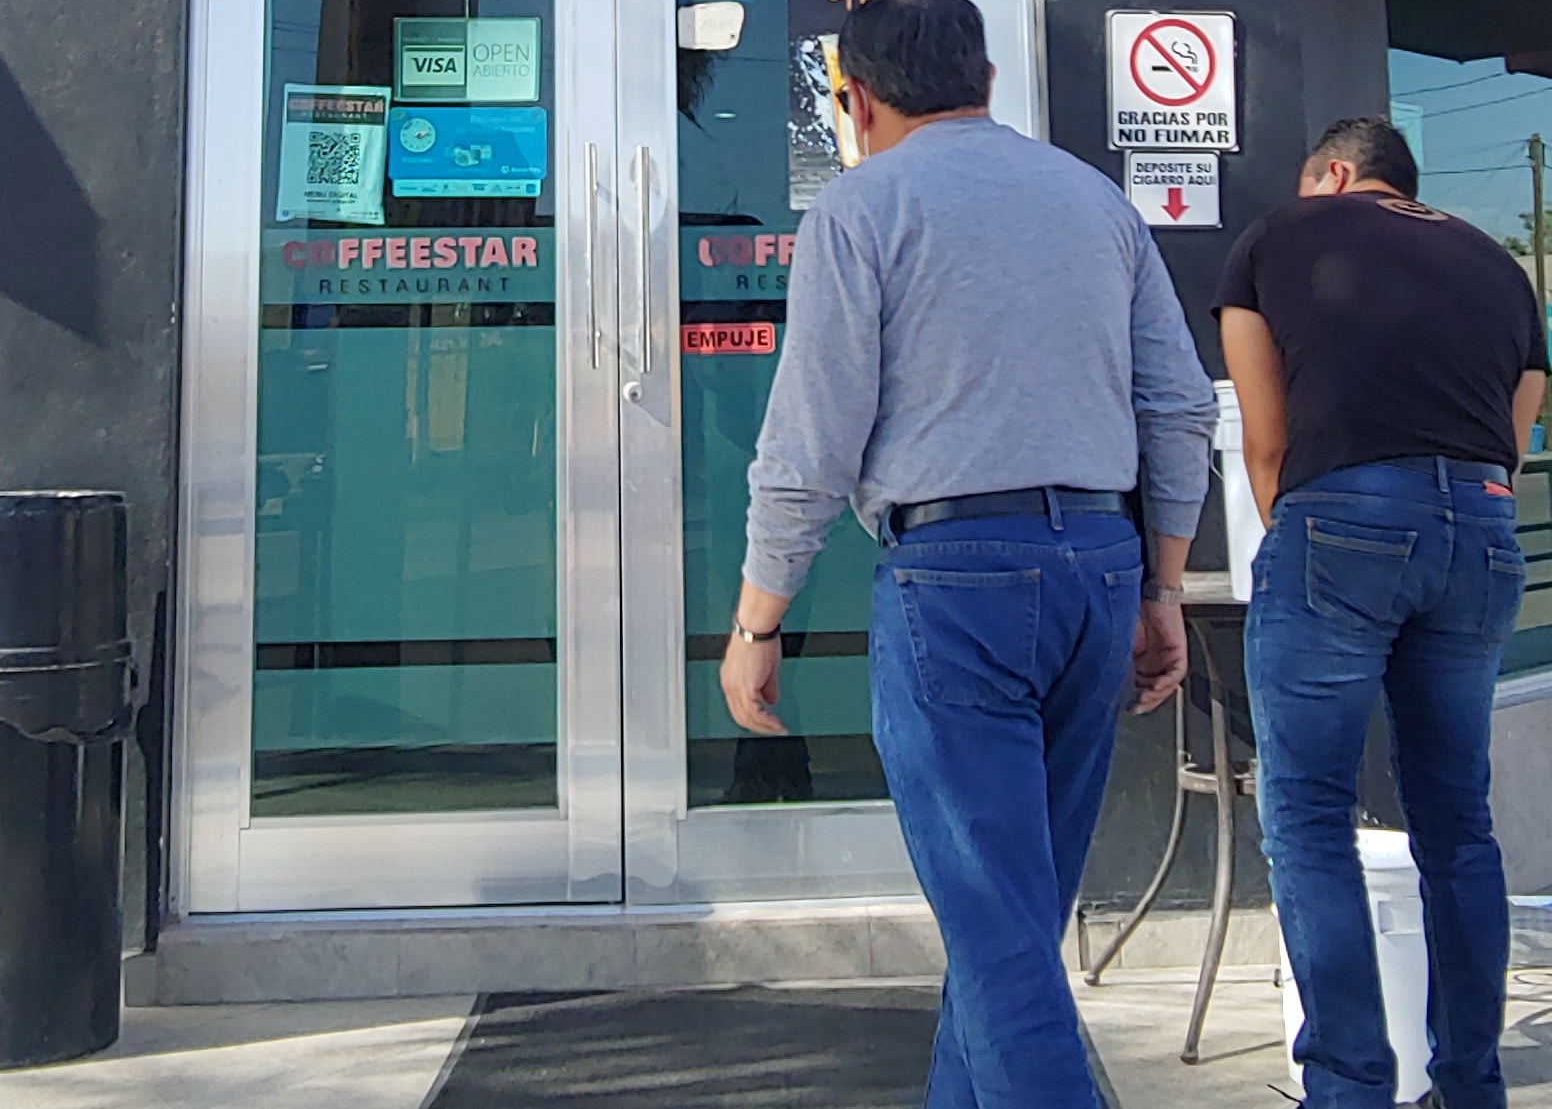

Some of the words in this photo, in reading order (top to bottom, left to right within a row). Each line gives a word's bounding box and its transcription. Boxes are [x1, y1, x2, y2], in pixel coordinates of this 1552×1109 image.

[473, 43, 530, 63] OPEN
[411, 57, 458, 73] VISA
[472, 64, 530, 78] ABIERTO
[1117, 111, 1190, 125] GRACIAS
[1196, 112, 1228, 126] POR
[1118, 128, 1146, 143] NO
[1155, 129, 1229, 143] FUMAR
[1135, 162, 1192, 173] DEPOSITE
[1196, 163, 1212, 173] SU
[1132, 174, 1184, 185] CIGARRO
[282, 236, 538, 269] COFFEESTAR
[319, 277, 510, 295] RESTAURANT
[687, 329, 769, 348] EMPUJE
